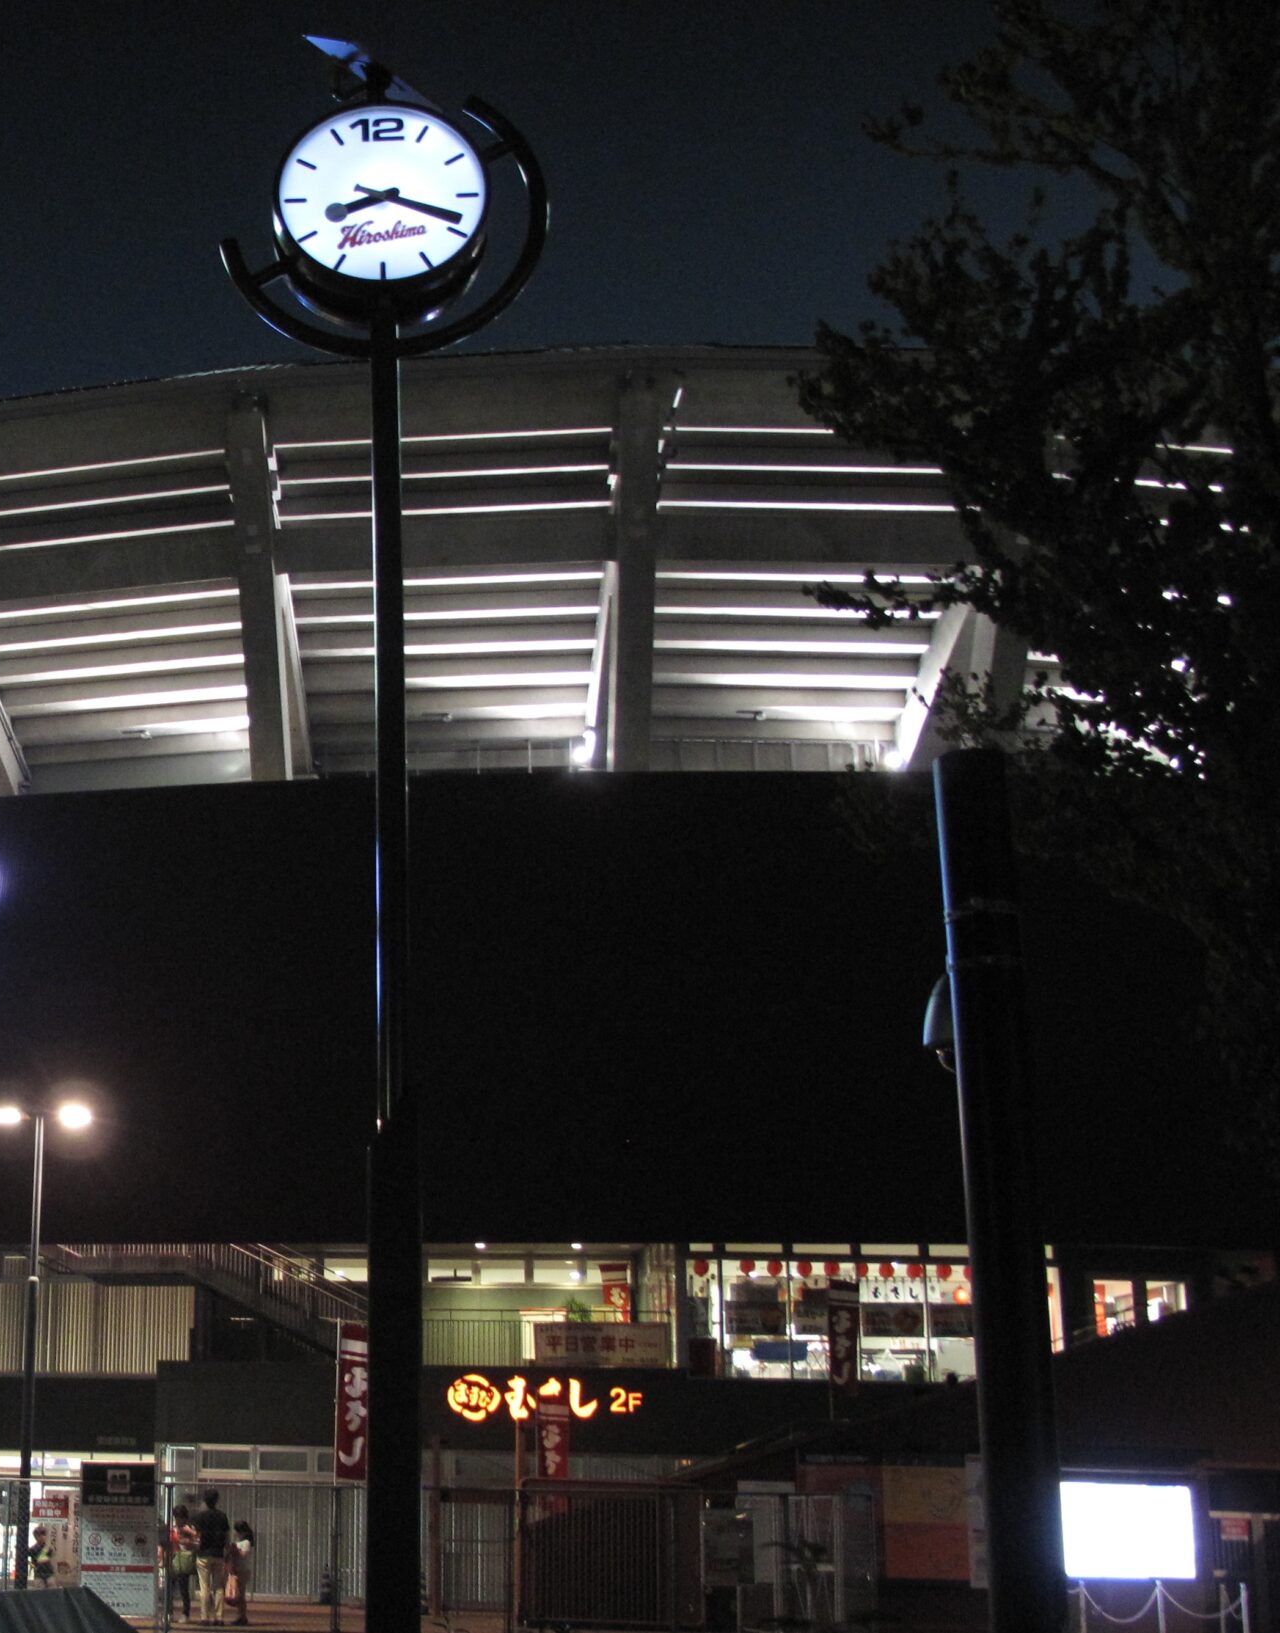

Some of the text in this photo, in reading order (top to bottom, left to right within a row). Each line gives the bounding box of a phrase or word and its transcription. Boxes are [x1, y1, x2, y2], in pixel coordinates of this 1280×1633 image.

[349, 118, 405, 142] 12
[337, 220, 428, 250] Hiroshima
[609, 1386, 642, 1412] 2F
